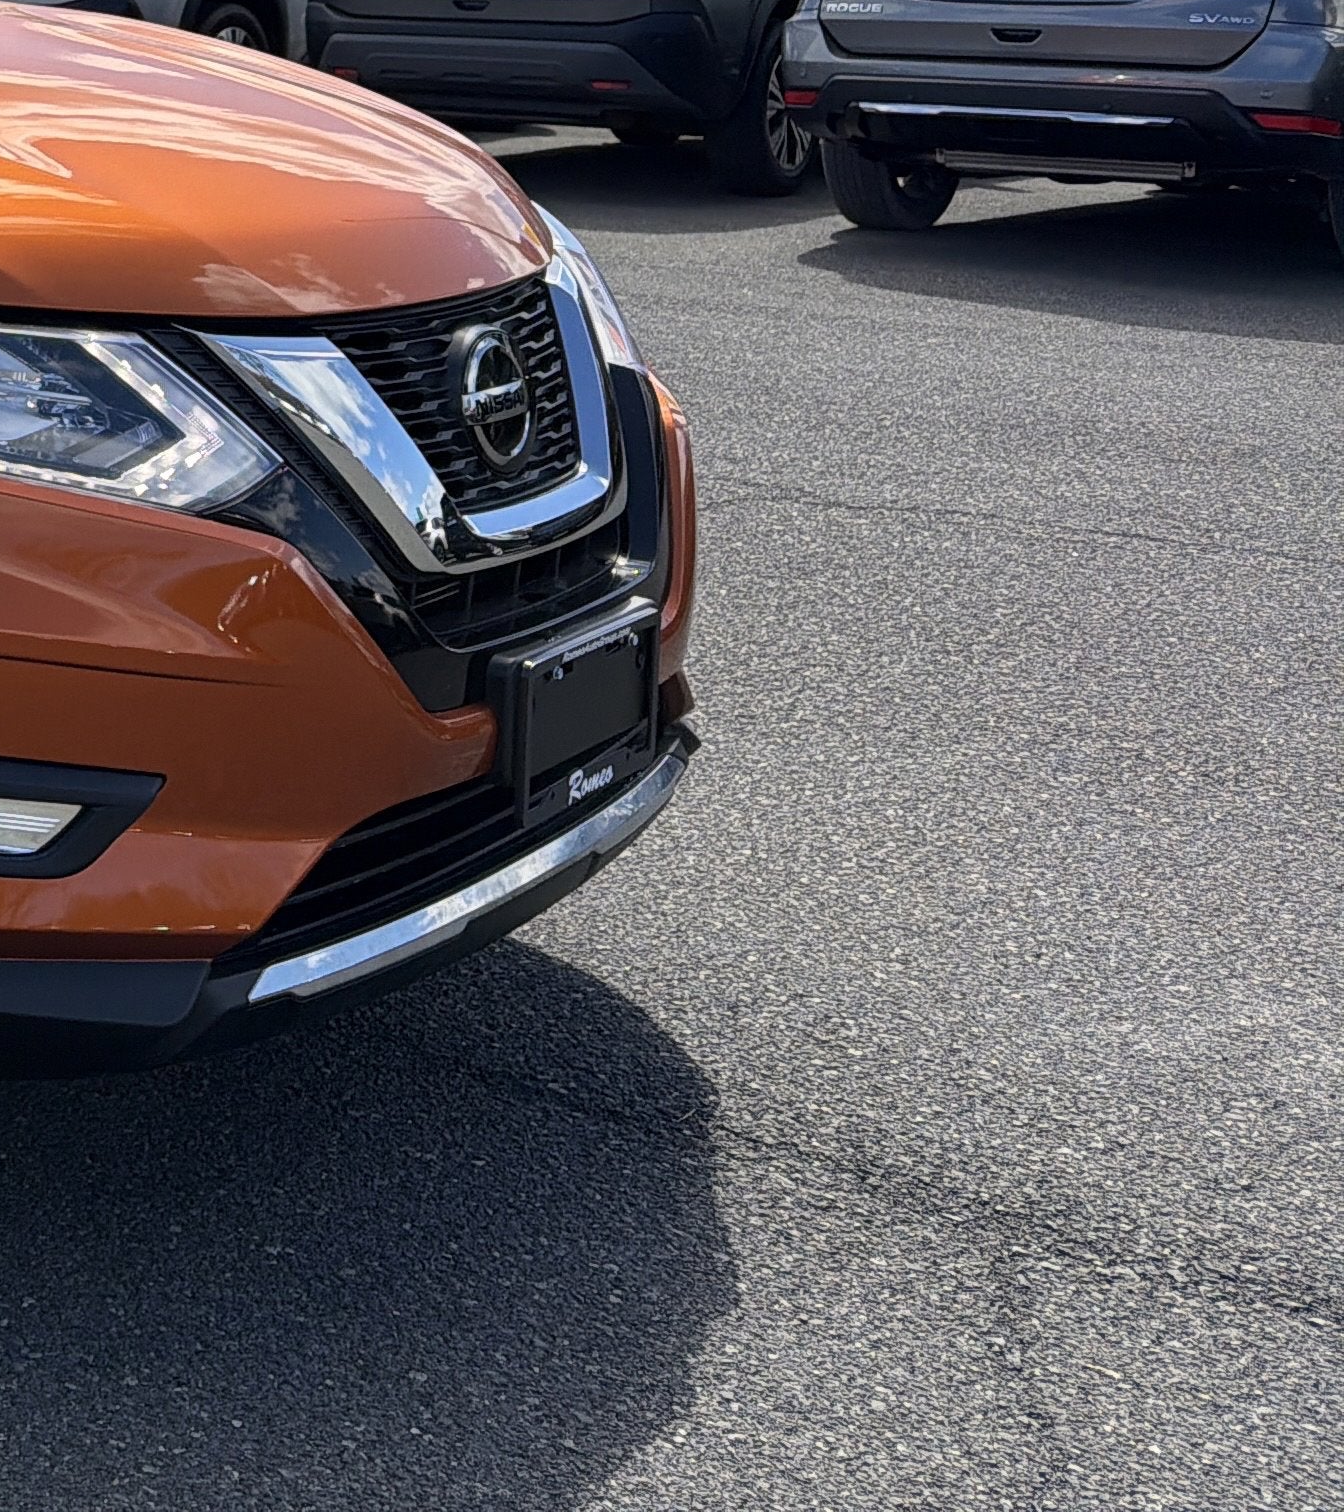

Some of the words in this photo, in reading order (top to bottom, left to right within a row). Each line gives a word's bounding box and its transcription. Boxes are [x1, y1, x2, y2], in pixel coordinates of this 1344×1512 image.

[826, 2, 883, 13] ROGUE
[1189, 13, 1221, 23] SV
[1218, 16, 1255, 24] AWD
[474, 390, 523, 420] NISSA
[568, 764, 614, 807] Romeo
